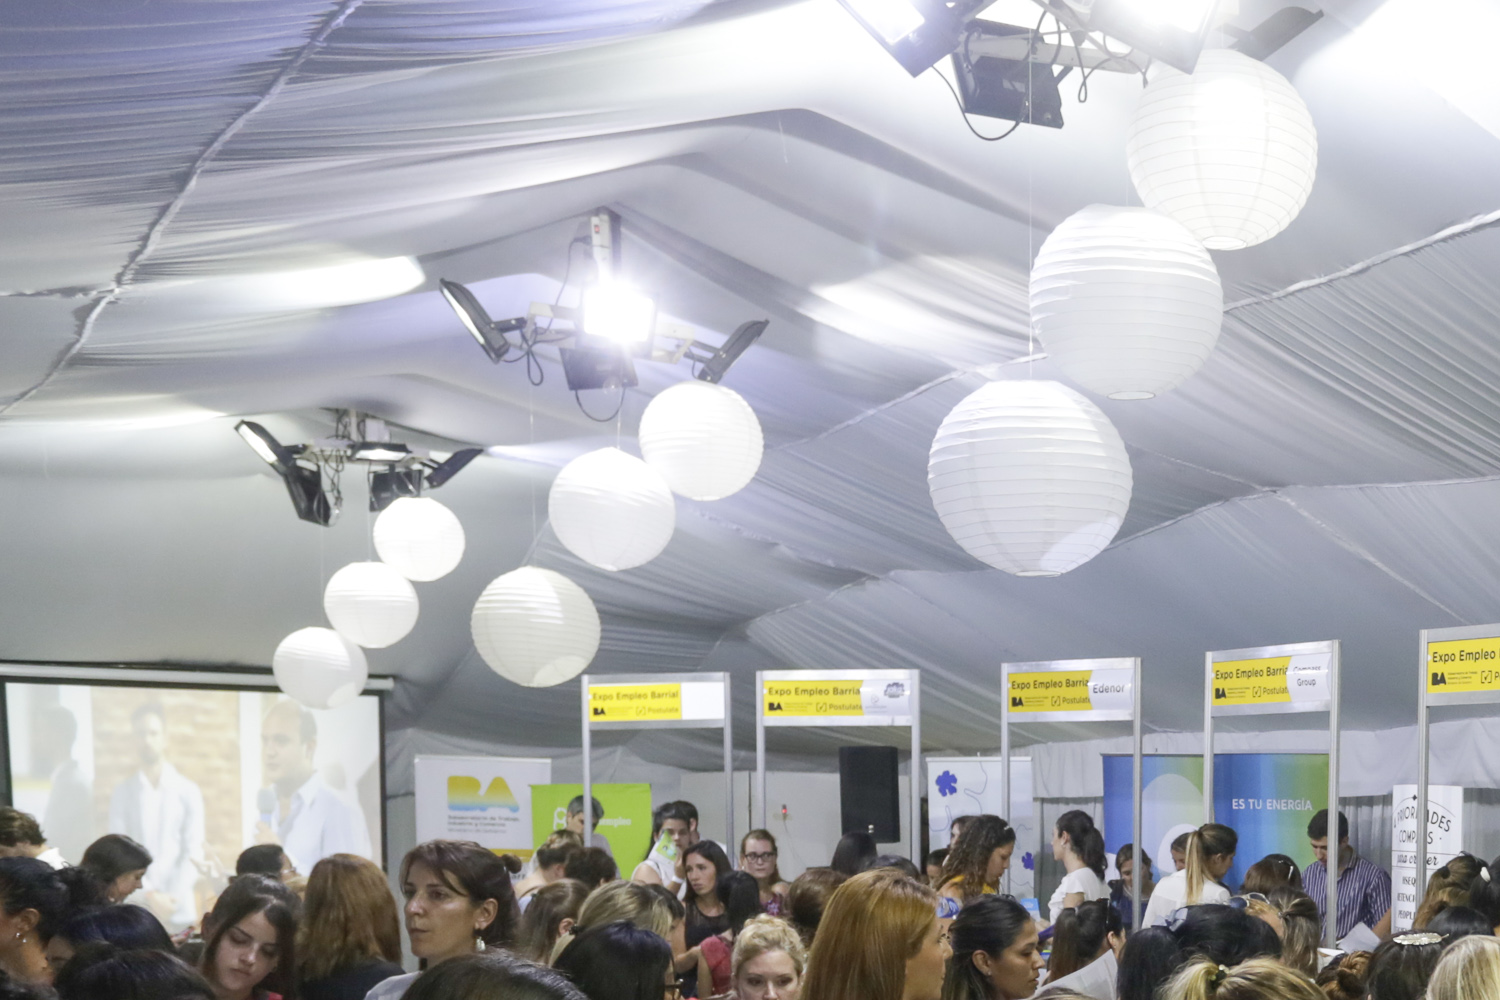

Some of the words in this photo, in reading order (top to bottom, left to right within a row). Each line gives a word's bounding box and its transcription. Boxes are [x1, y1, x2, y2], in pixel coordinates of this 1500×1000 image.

[1432, 651, 1456, 664] Expo
[1459, 649, 1496, 663] Empleo
[1215, 670, 1233, 681] Expo
[1236, 668, 1264, 679] Empleo
[1011, 681, 1031, 690] Expo
[1033, 679, 1062, 690] Empleo
[1297, 678, 1317, 687] Group
[768, 687, 791, 696] Expo
[795, 687, 830, 696] Empleo
[1093, 683, 1125, 694] Edenor
[593, 692, 613, 701] Expo
[616, 691, 648, 701] Empleo
[651, 690, 679, 699] Barrial
[1232, 799, 1245, 810] ES
[1248, 799, 1262, 810] TU
[1266, 798, 1313, 811] ENERGÍA
